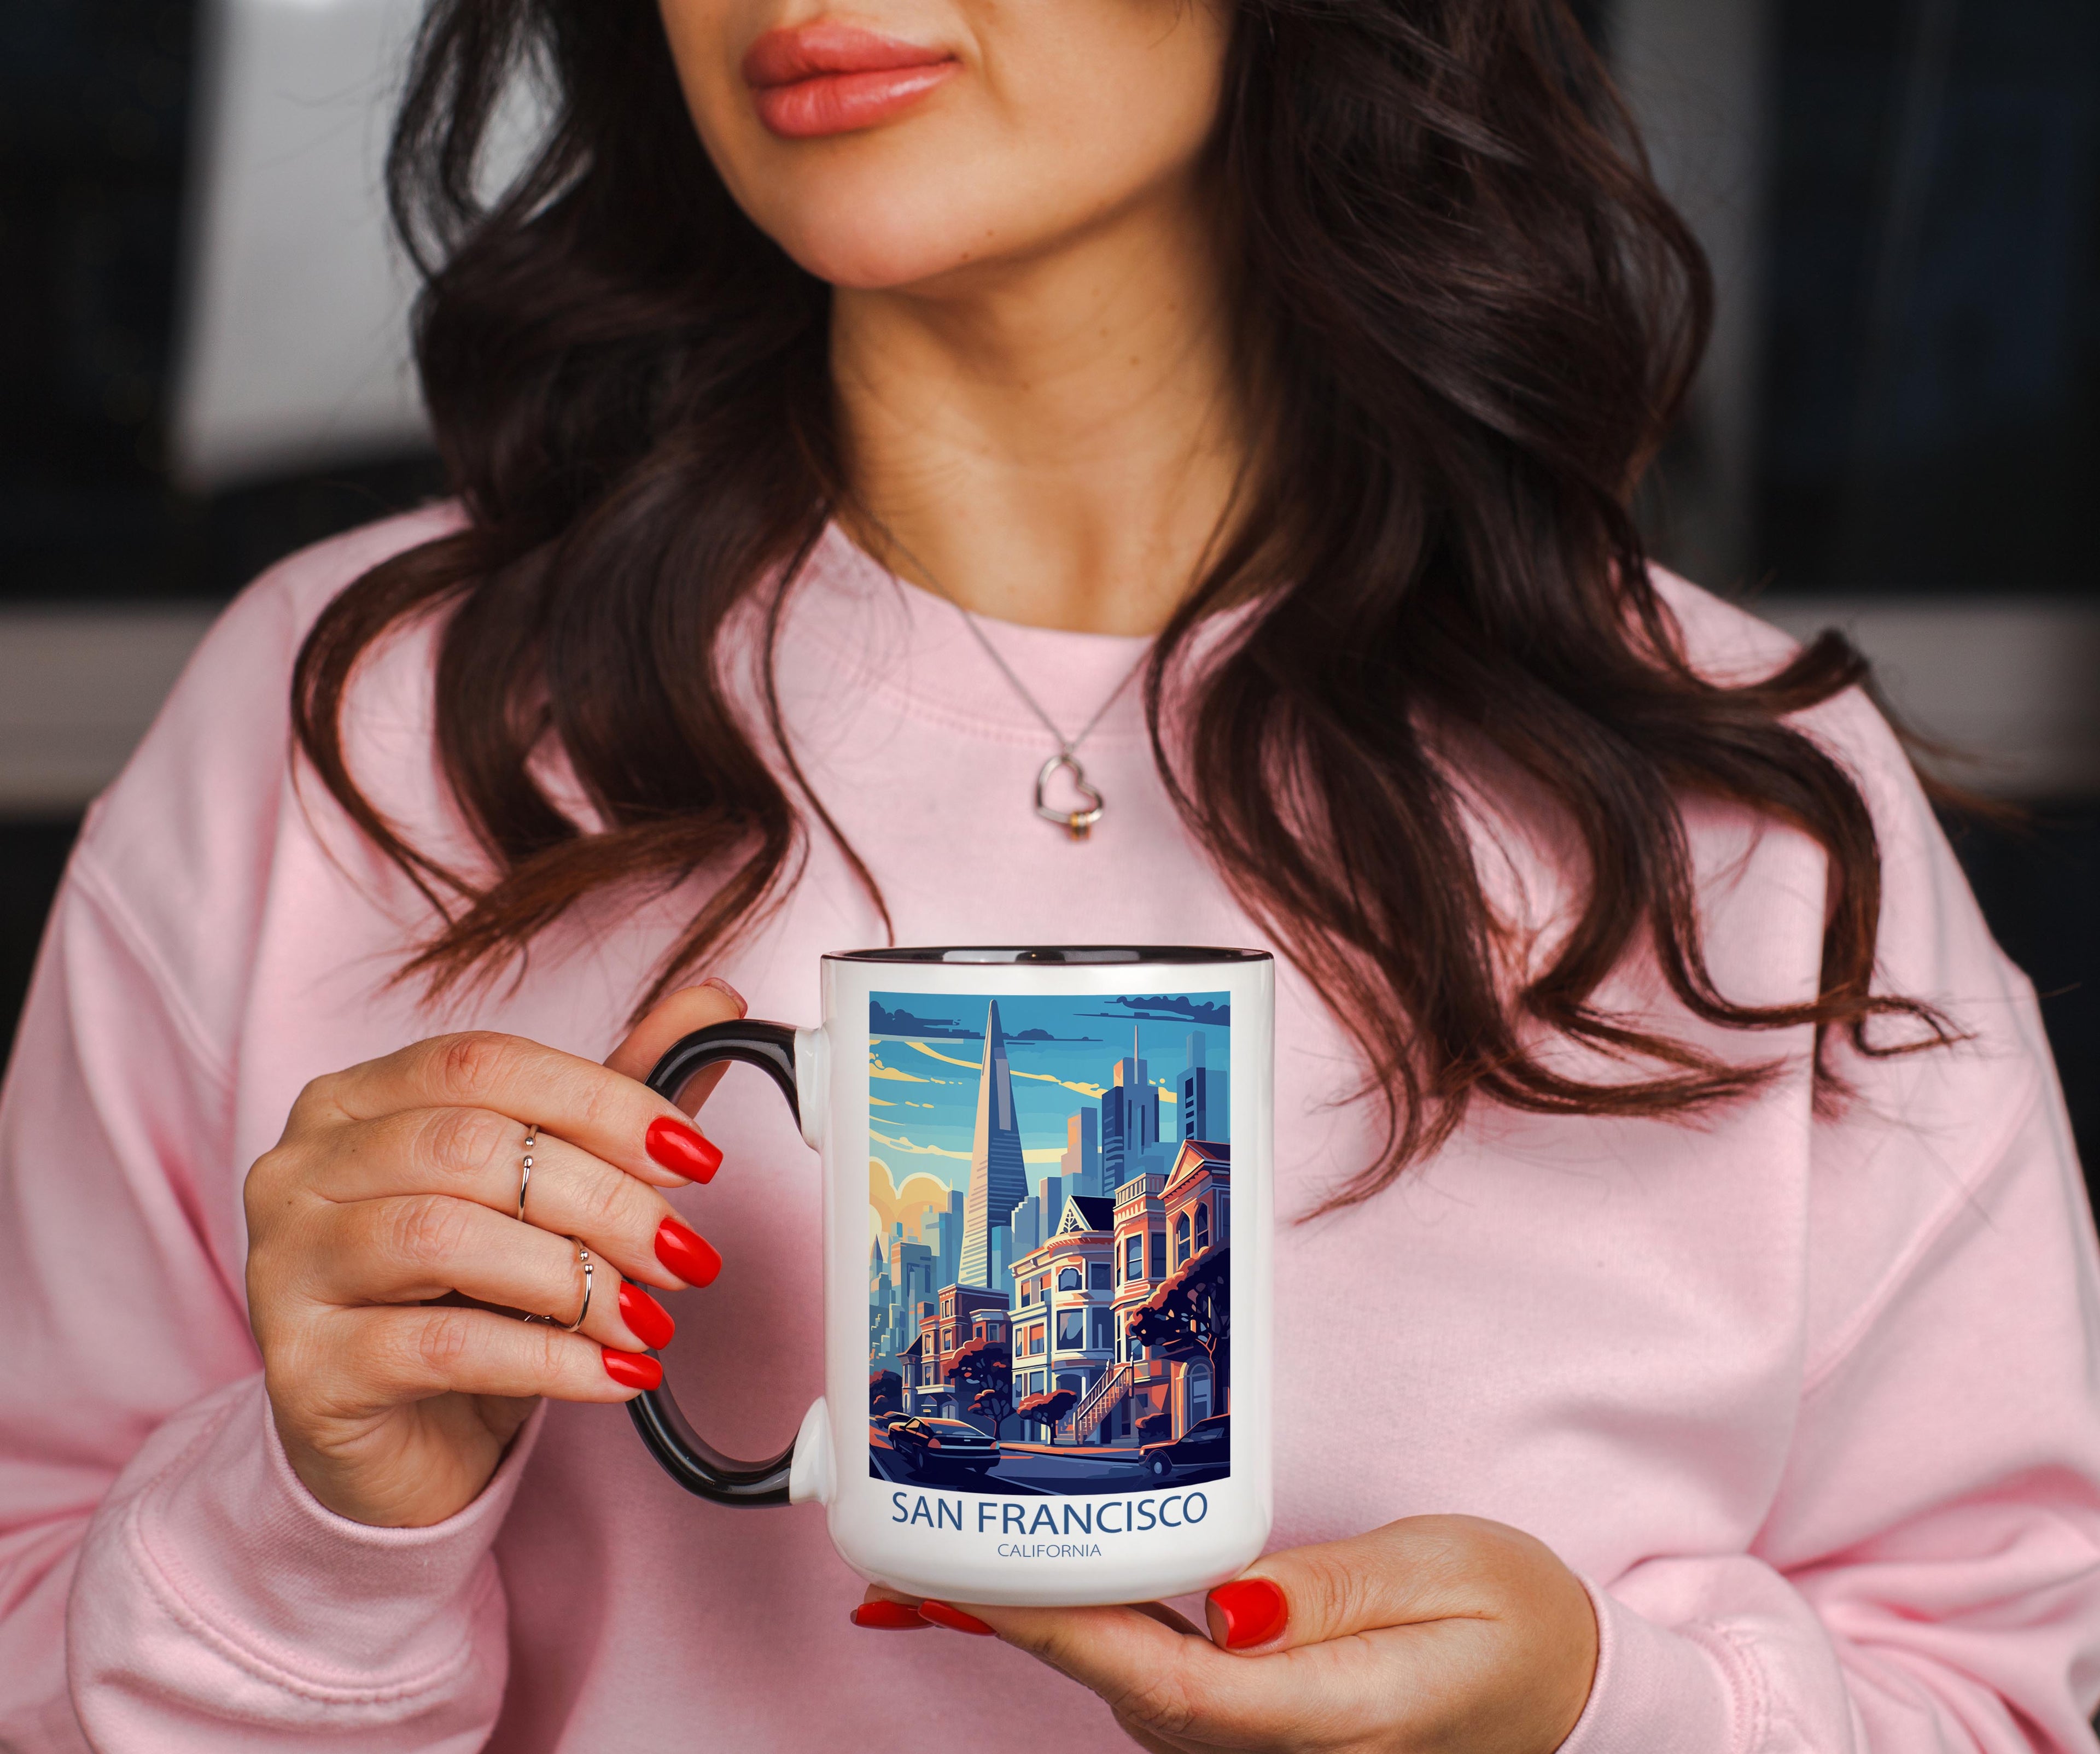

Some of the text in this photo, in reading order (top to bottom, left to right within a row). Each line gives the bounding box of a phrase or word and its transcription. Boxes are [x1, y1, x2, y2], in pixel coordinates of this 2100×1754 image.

[891, 1492, 1208, 1535] SAN FRANCISCO
[997, 1543, 1102, 1558] CALIFORNIA
